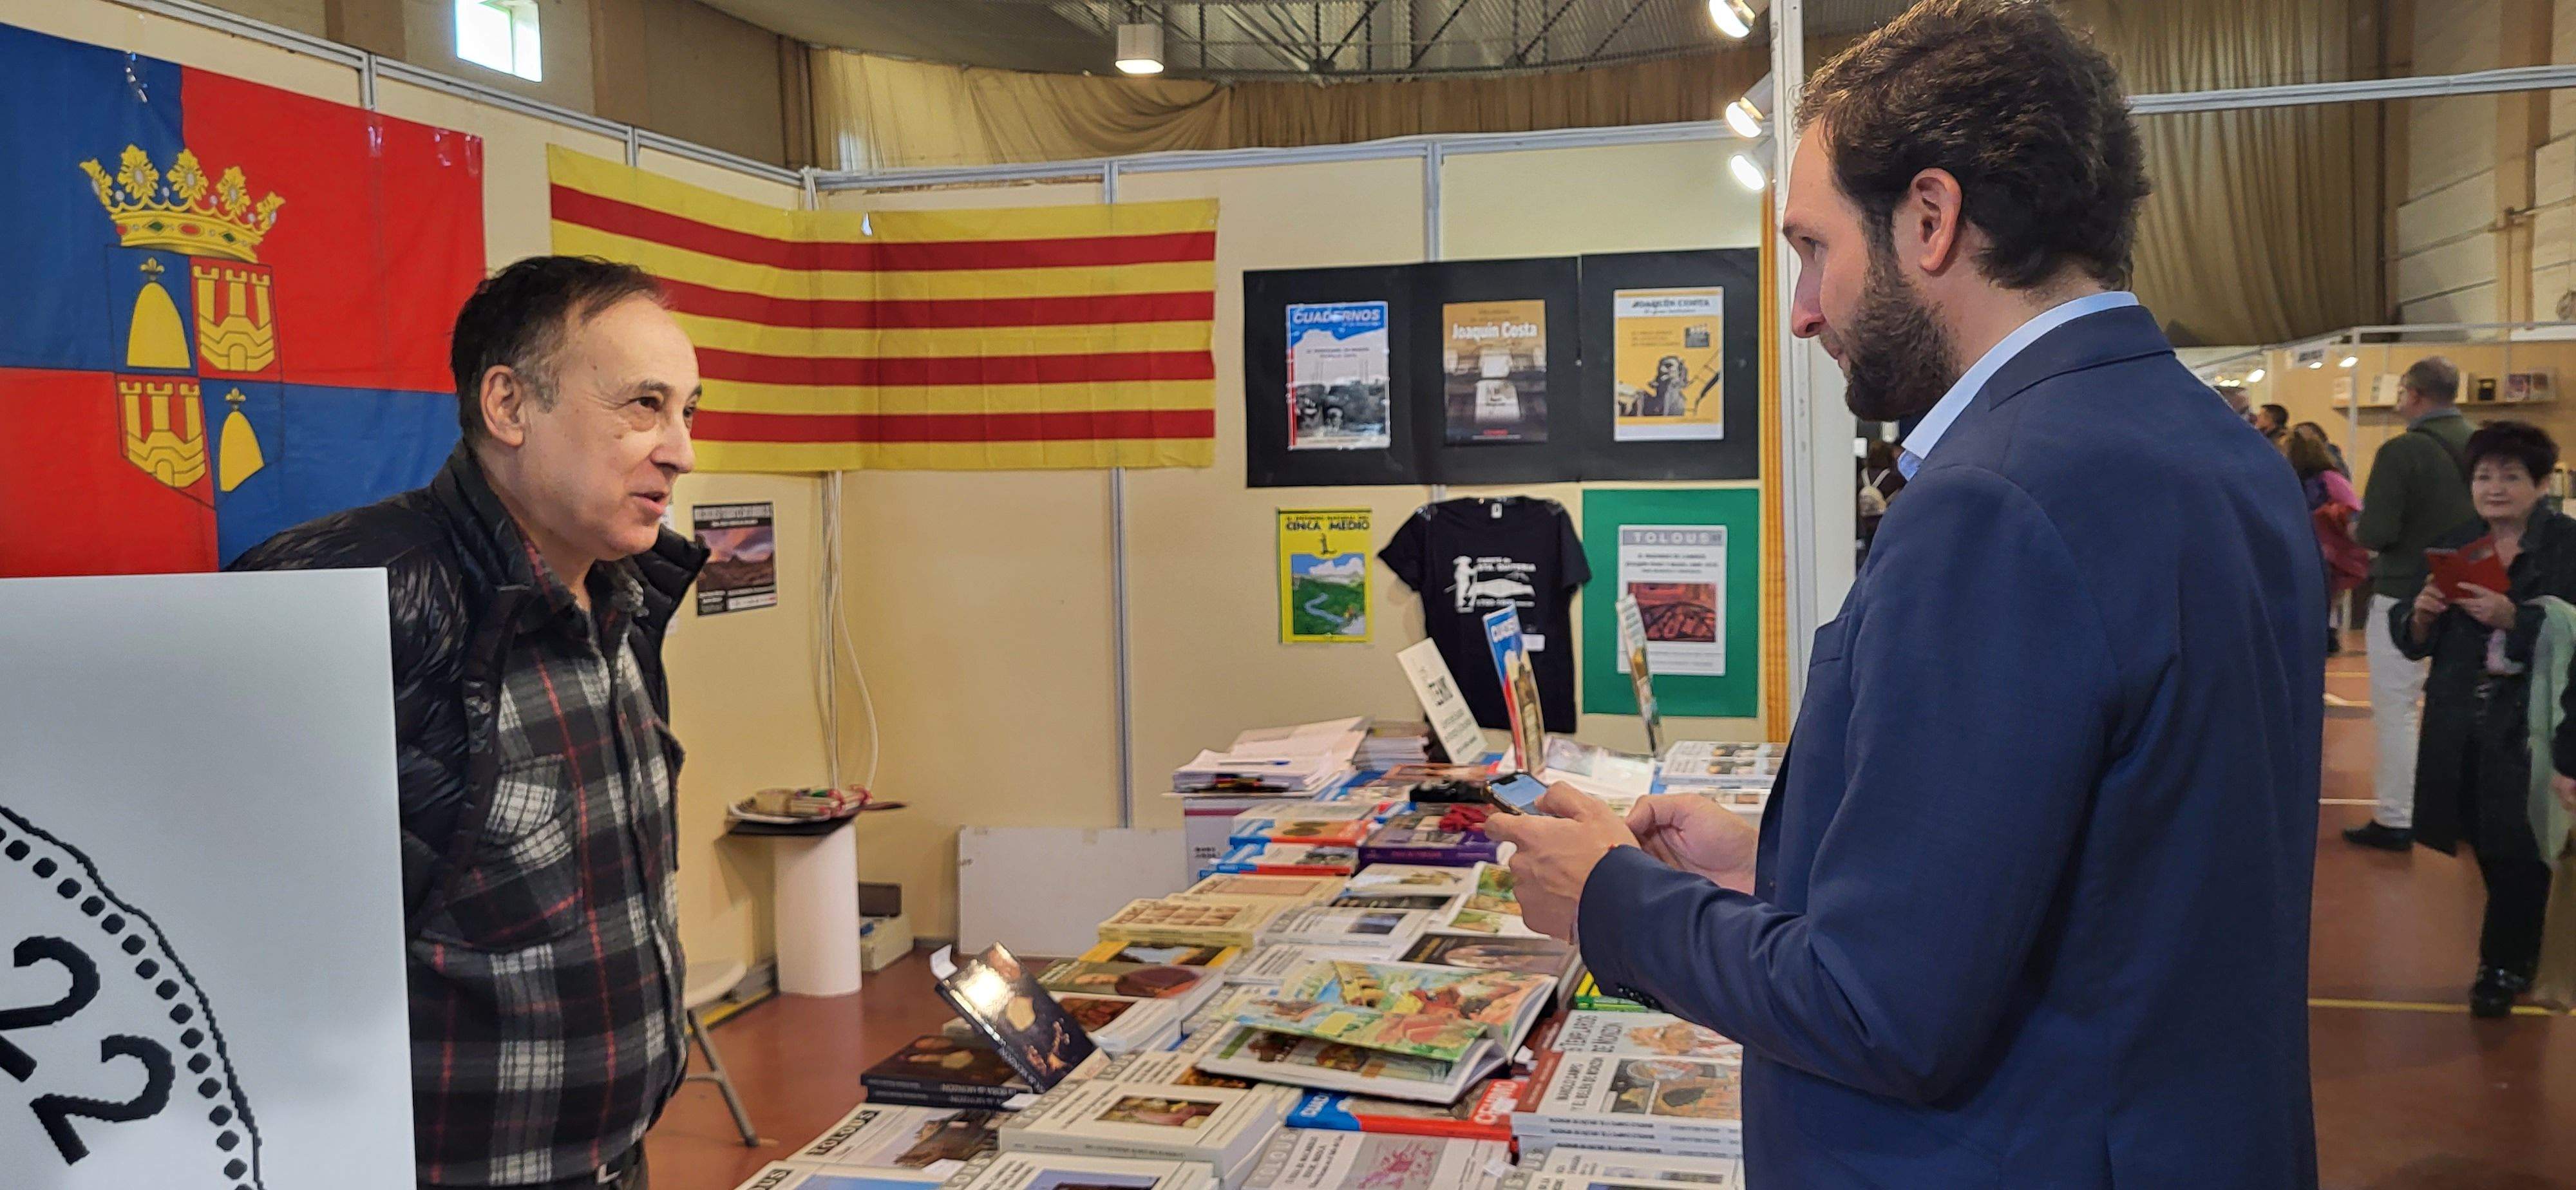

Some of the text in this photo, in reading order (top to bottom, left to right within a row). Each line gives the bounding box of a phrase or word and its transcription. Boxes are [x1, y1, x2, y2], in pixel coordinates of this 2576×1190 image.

[1501, 321, 1538, 337] Costa
[1287, 520, 1370, 530] CINCA MEDIO
[1633, 531, 1710, 544] TOLOUS
